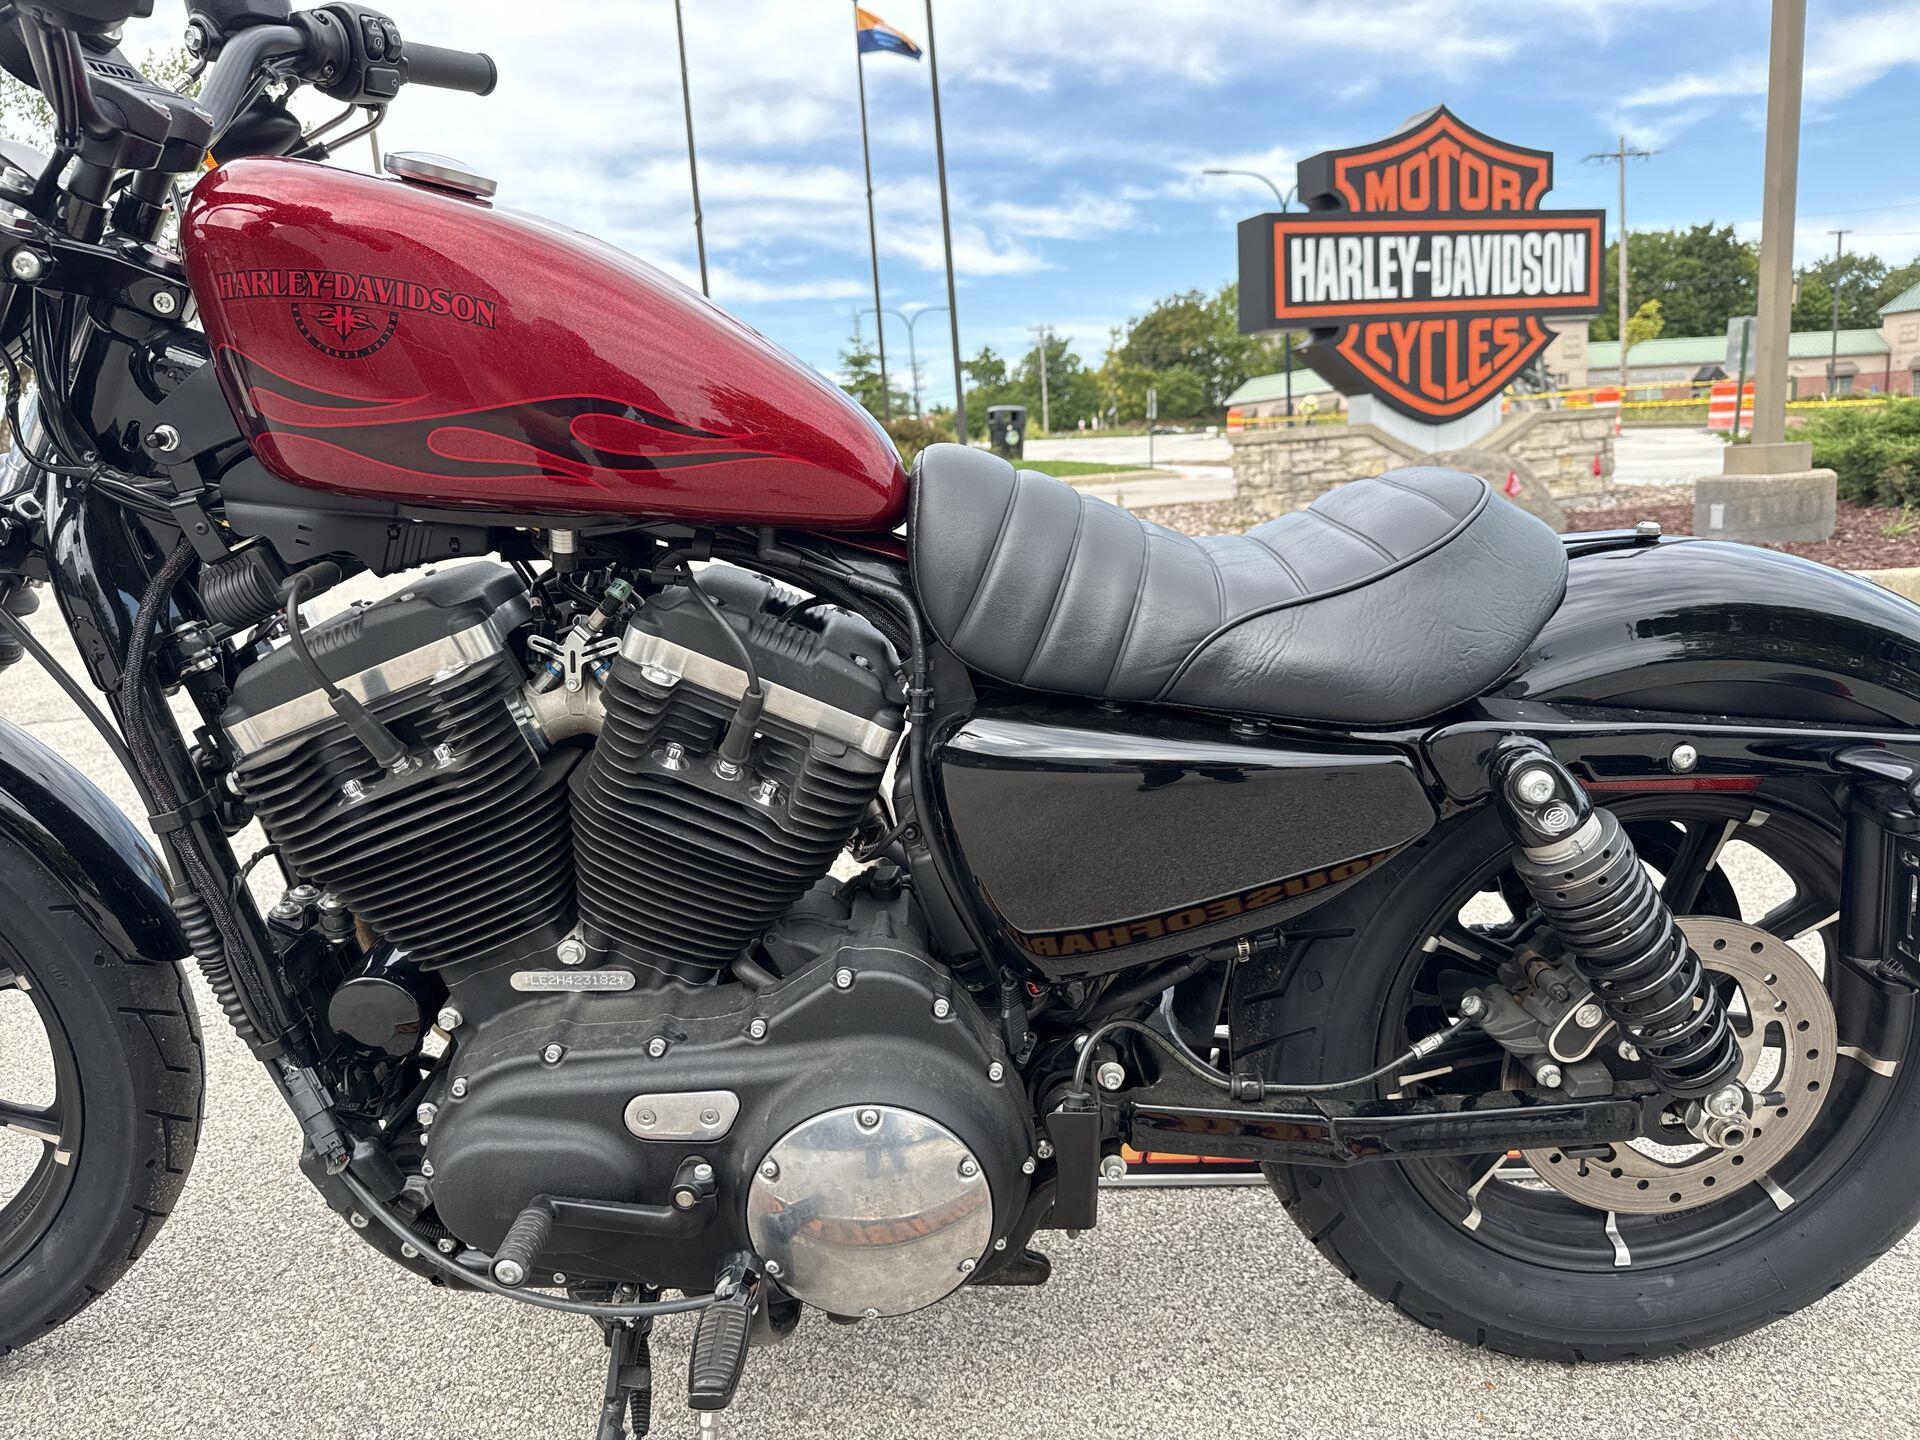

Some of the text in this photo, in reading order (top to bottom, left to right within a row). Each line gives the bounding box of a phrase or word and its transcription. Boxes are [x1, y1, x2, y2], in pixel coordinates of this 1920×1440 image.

[1365, 136, 1522, 212] MOTOR
[217, 268, 497, 330] HARLEY-DAVIDSON
[1290, 231, 1586, 303] HARLEY-DAVIDSON
[1364, 316, 1520, 401] CYCLES
